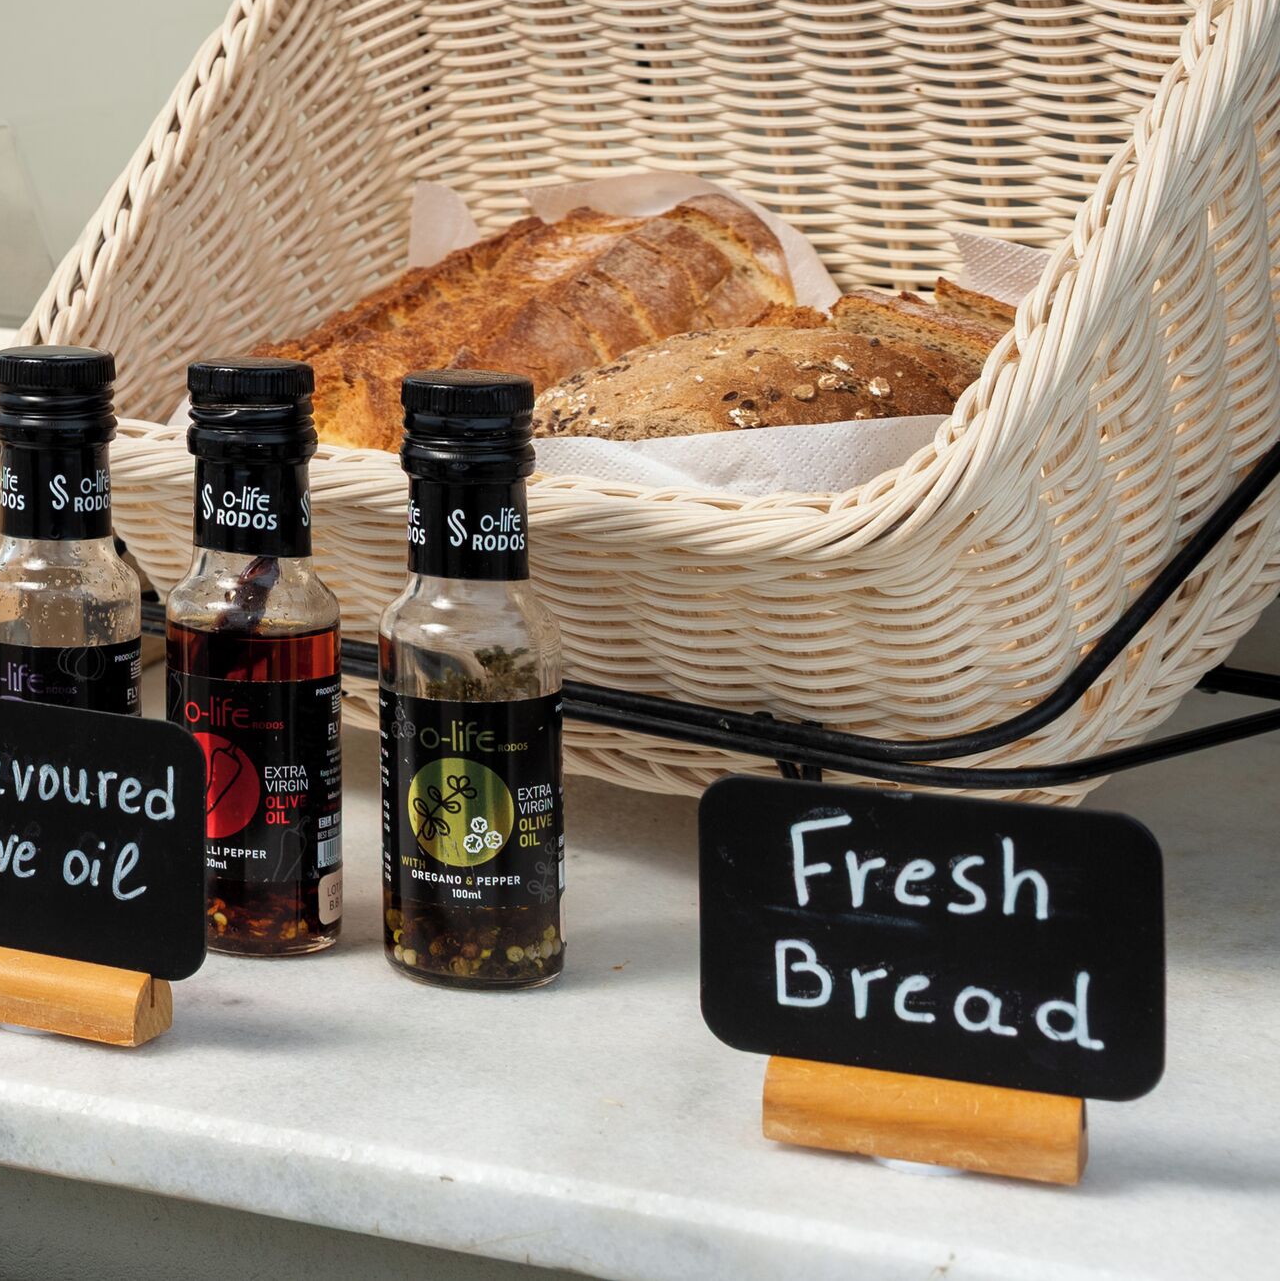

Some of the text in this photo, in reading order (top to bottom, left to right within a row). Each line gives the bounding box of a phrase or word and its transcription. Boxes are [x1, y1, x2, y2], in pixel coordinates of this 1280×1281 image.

[216, 508, 278, 531] RODOS
[472, 533, 525, 551] RODOS
[252, 721, 285, 730] RODOS
[497, 742, 529, 752] RODOS
[264, 765, 307, 779] EXTRA
[265, 778, 309, 793] VIRGIN
[517, 783, 553, 801] EXTRA
[265, 794, 308, 810] OLIVE
[518, 797, 554, 815] VIRGIN
[265, 811, 291, 825] OIL
[519, 813, 553, 832] OLIVE
[519, 837, 541, 848] OIL
[224, 848, 267, 859] PEPPER
[401, 855, 427, 868] WITH
[62, 841, 147, 901] oil
[790, 815, 1049, 920] Fresh
[411, 869, 521, 887] OREGANO & PEPPER
[452, 888, 482, 900] 100ml
[775, 938, 1105, 1051] Bread
